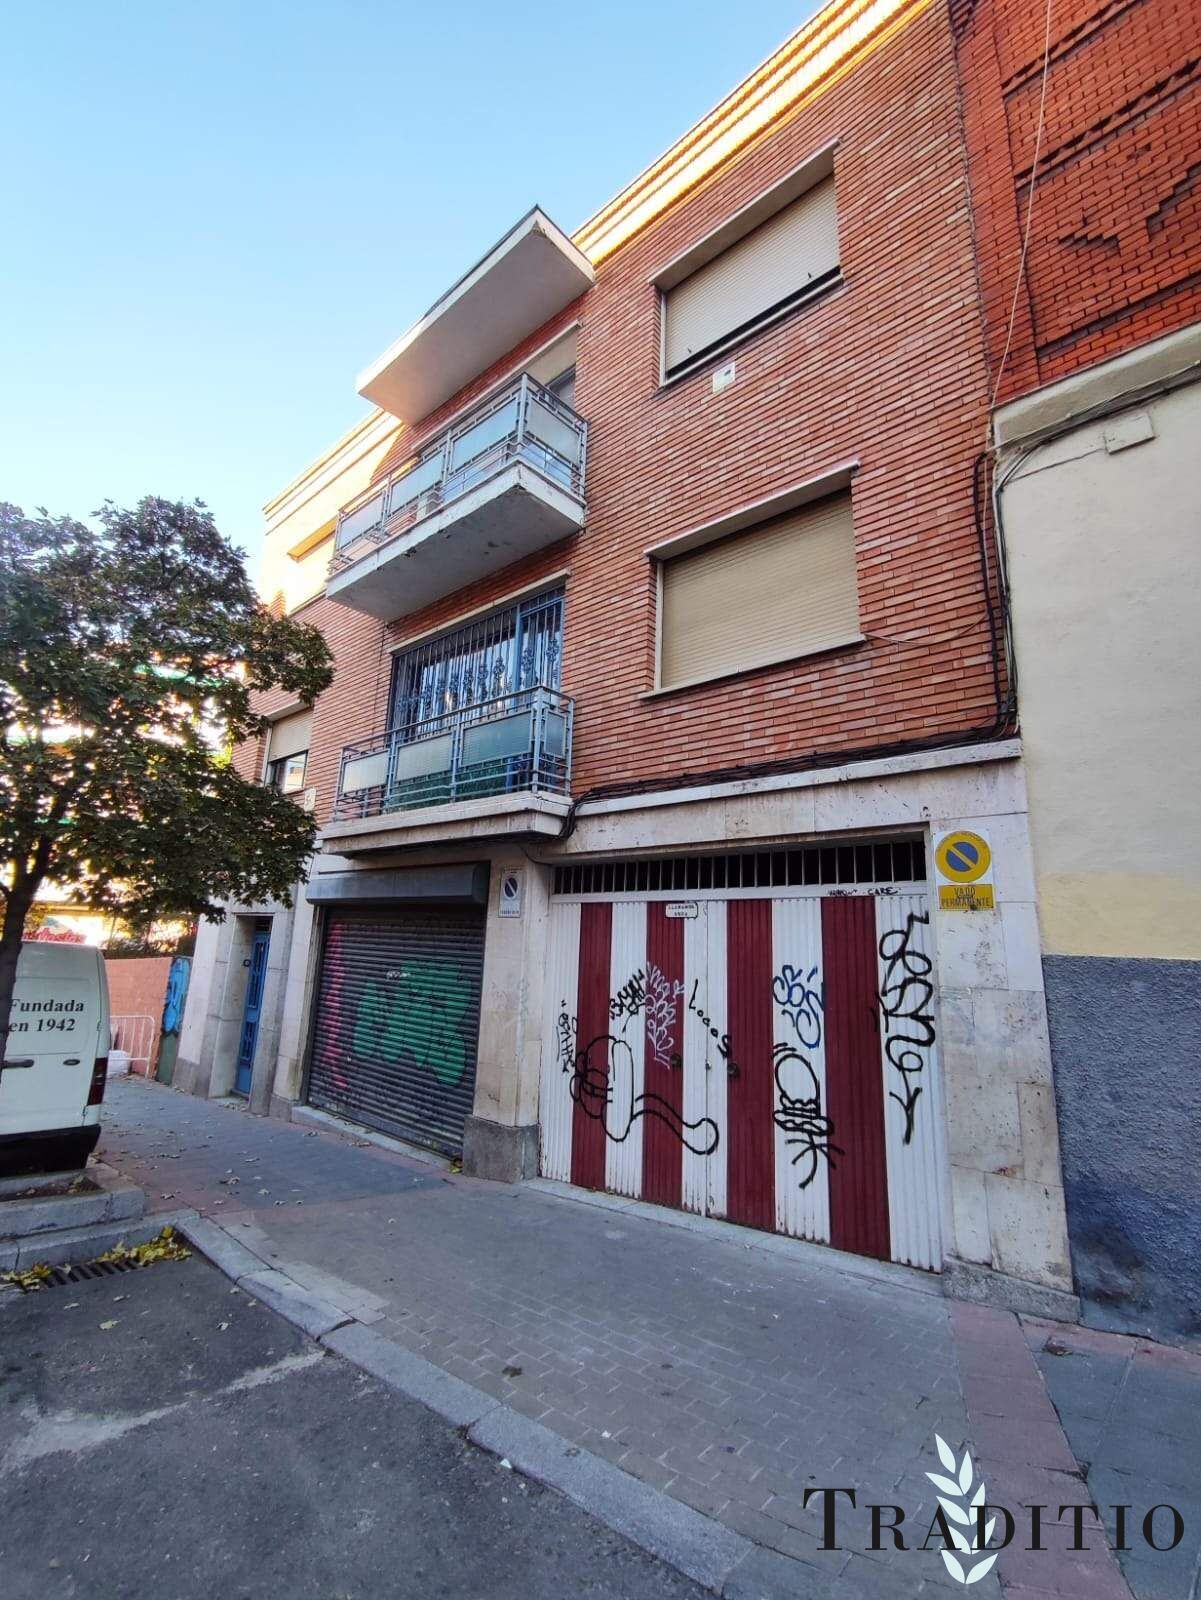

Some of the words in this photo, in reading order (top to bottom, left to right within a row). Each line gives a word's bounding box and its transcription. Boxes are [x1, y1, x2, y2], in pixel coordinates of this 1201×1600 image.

[10, 998, 85, 1013] Fundada
[8, 1022, 29, 1033] en
[36, 1018, 76, 1032] 1942
